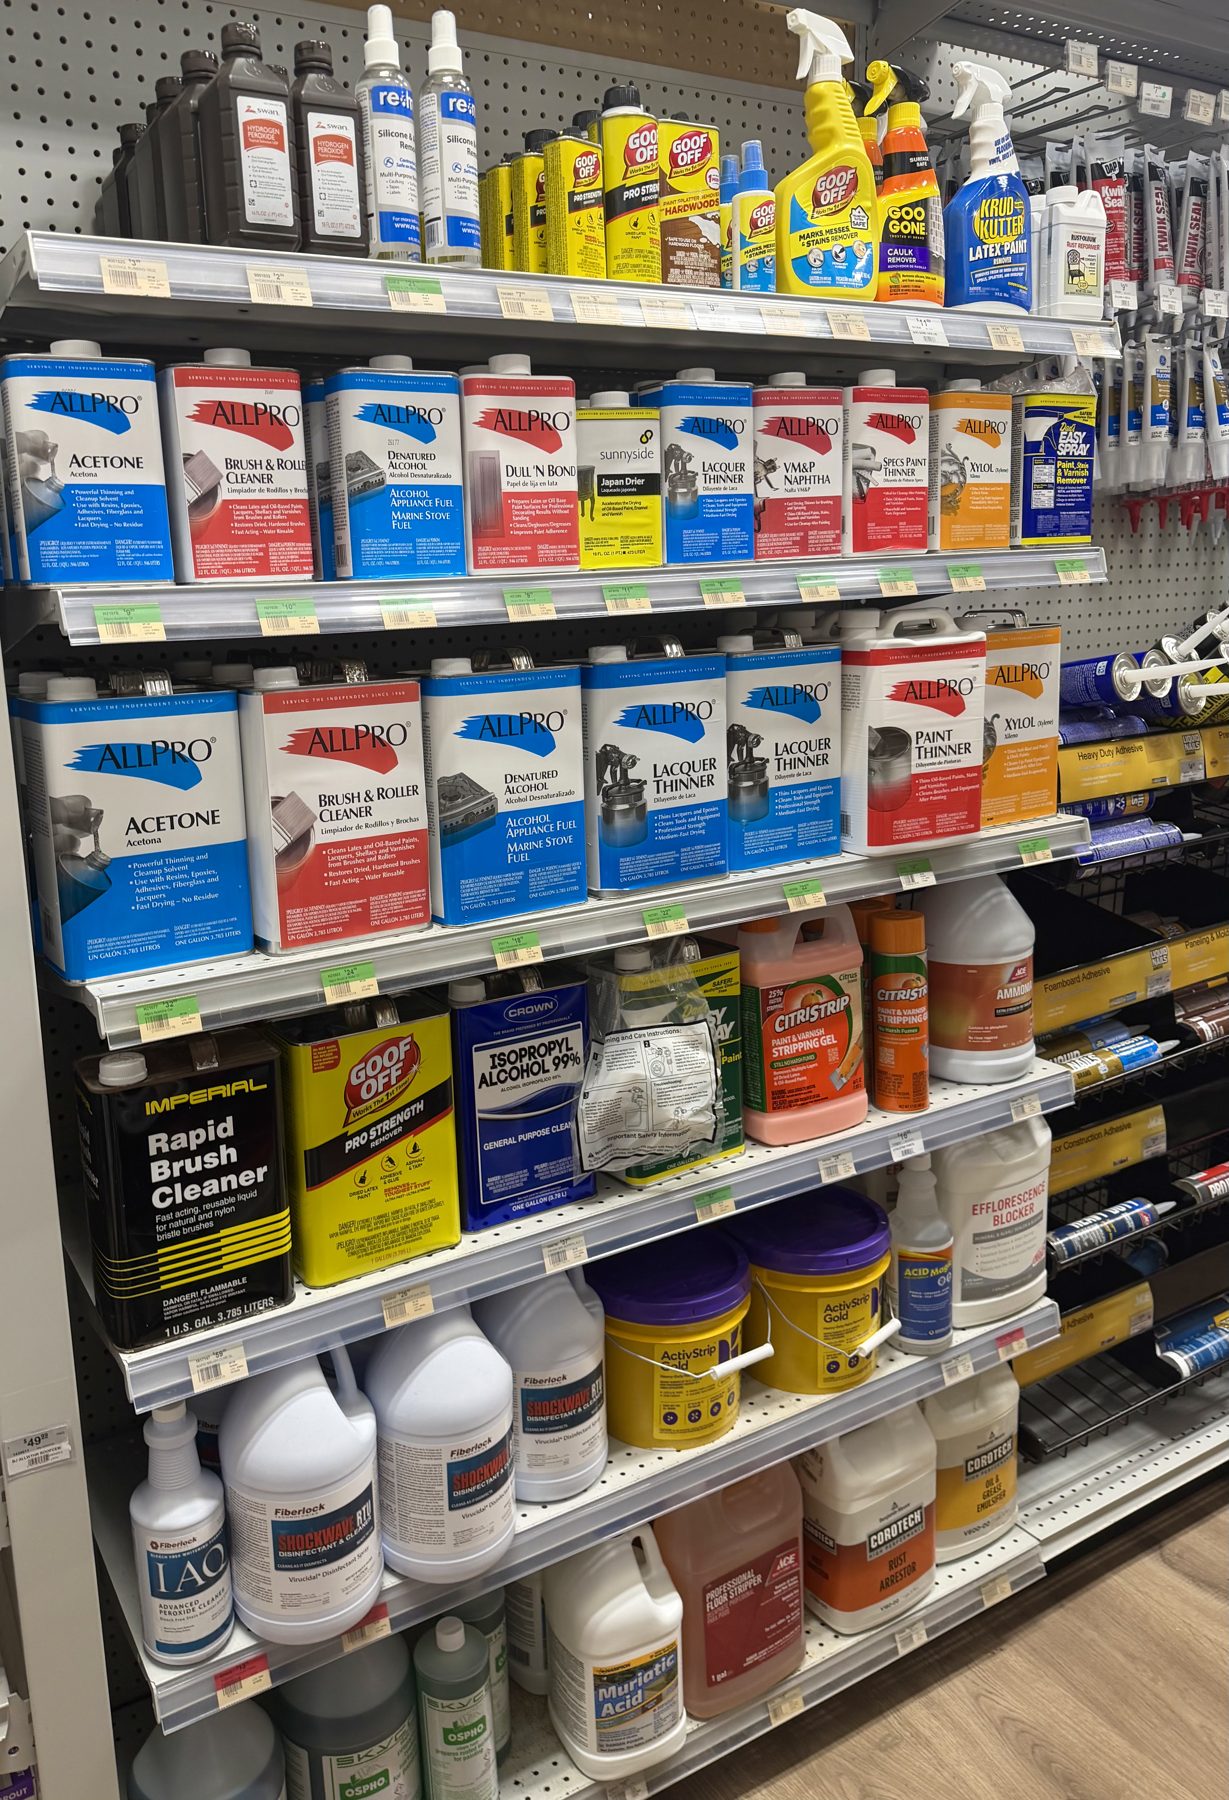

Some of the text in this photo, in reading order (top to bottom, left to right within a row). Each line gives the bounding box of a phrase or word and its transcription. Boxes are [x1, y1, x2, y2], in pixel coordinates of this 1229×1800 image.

[257, 108, 278, 116] swan
[248, 126, 279, 135] HYDROGEN
[318, 141, 348, 149] HYDROGEN
[673, 134, 707, 153] GOOF
[575, 155, 597, 166] GOOF
[678, 150, 702, 165] OFF
[579, 166, 594, 178] OFF
[1104, 160, 1117, 174] DAP
[817, 169, 855, 190] GOOF
[821, 186, 847, 205] OFF
[665, 201, 719, 215] HARDWOODS
[888, 207, 925, 221] GOO
[980, 196, 1013, 217] KRUD
[799, 226, 850, 241] MARKS, MESSES,
[889, 220, 926, 235] GONE
[980, 216, 1023, 240] KUTTER
[806, 237, 830, 247] STAINS
[831, 232, 858, 242] REMOVER
[969, 240, 1027, 261] LATEX PAINT
[888, 256, 916, 264] REMOVER
[1059, 432, 1085, 444] EASY
[388, 451, 436, 461] DENATURED
[600, 450, 654, 463] sunnyside
[1057, 443, 1089, 456] SPRAY
[69, 454, 143, 469] ACETONE
[388, 461, 428, 470] ALCOHOL
[702, 462, 745, 474] LACQUER
[784, 462, 815, 473] VM&P
[883, 458, 927, 467] SPECS PAINT
[970, 462, 994, 473] XYLOL
[226, 472, 274, 484] CLEANER
[506, 465, 531, 478] DULL
[549, 466, 576, 477] BOND
[703, 474, 744, 484] THINNER
[784, 474, 831, 485] NAPHTHA
[883, 468, 916, 477] THINNER
[601, 478, 645, 487] Japan Drier
[1057, 477, 1087, 485] Remover
[390, 489, 430, 498] ALCOHOL
[391, 499, 454, 508] APPLIANCE FUEL
[392, 511, 450, 520] MARINE STOVE
[392, 520, 412, 529] FUEL
[1005, 717, 1035, 731] XYLOL
[915, 729, 953, 745] PAINT
[775, 737, 831, 756] LACQUER
[915, 742, 972, 760] THINNER
[1078, 744, 1143, 761] Heavy Duty Adhesive
[653, 757, 717, 778] LACQUER
[774, 753, 829, 772] THINNER
[504, 770, 558, 785] DENATURED
[653, 773, 715, 795] THINNER
[319, 785, 419, 808] BRUSH & ROLLER
[504, 781, 549, 795] ALCOHOL
[125, 809, 221, 835] ACETONE
[319, 807, 373, 822] CLEANER
[506, 814, 550, 828] ALCOHOL
[506, 820, 577, 839] APPLIANCE FUEL
[126, 837, 162, 847] Acetona
[507, 835, 573, 853] MARINE STOVE
[507, 853, 530, 864] FUEL
[1152, 955, 1168, 966] NAILS
[839, 972, 857, 981] Citrus
[1044, 967, 1111, 992] Foamboard Adhesive
[508, 1001, 554, 1018] CROWN
[775, 995, 850, 1033] CITRISTRIP
[490, 1037, 573, 1070] ISOPROPYL
[772, 1035, 837, 1057] STRIPPING GEL
[350, 1036, 413, 1087] GOOF
[478, 1063, 550, 1089] ALCOHOL
[552, 1051, 581, 1072] 99%
[1066, 1052, 1100, 1071] NAILS
[360, 1062, 403, 1100] OFF
[145, 1078, 268, 1116] IMPERIAL
[344, 1099, 425, 1154] PRO STRENGTH
[148, 1115, 234, 1157] Rapid
[370, 1126, 403, 1148] REMOVER
[483, 1136, 517, 1151] GENERAL
[518, 1127, 551, 1143] PURPOSE
[1064, 1121, 1132, 1150] Construction Adhesive
[150, 1144, 238, 1184] Brush
[152, 1164, 268, 1210] Cleaner
[972, 1181, 1045, 1216] EFFLORESCENCE
[156, 1205, 236, 1233] for natural and nylon
[993, 1203, 1034, 1227] BLOCKER
[157, 1220, 214, 1242] bristle brushes
[904, 1267, 929, 1277] ACID
[823, 1293, 870, 1313] ActivStrip
[823, 1311, 849, 1324] Gold
[661, 1344, 716, 1361] ActivStrip
[524, 1374, 567, 1385] Fiberlock
[527, 1388, 591, 1416] SHOCKWAVE
[526, 1409, 577, 1421] DISINFECTANT
[450, 1437, 492, 1458] Fiberlock
[967, 1439, 1013, 1473] COROTECH
[982, 1483, 1002, 1500] GREASE
[275, 1503, 325, 1516] Fiberlock
[976, 1490, 1006, 1513] EMULSIFIER
[278, 1500, 372, 1551] SHOCKWAVE RTU
[870, 1509, 922, 1548] COROTECH
[160, 1537, 197, 1548] Fiberlock
[776, 1553, 796, 1571] ACE
[888, 1552, 907, 1571] RUST
[879, 1562, 917, 1592] ARRESTOR
[706, 1569, 755, 1603] PROFESSIONAL
[706, 1574, 762, 1612] FLOOR STRIPPER
[159, 1600, 199, 1610] ADVANCED
[599, 1654, 675, 1701] Muriatic
[601, 1690, 642, 1717] Acid
[448, 1722, 484, 1742] OSPHO
[345, 1776, 386, 1797] OSPHO
